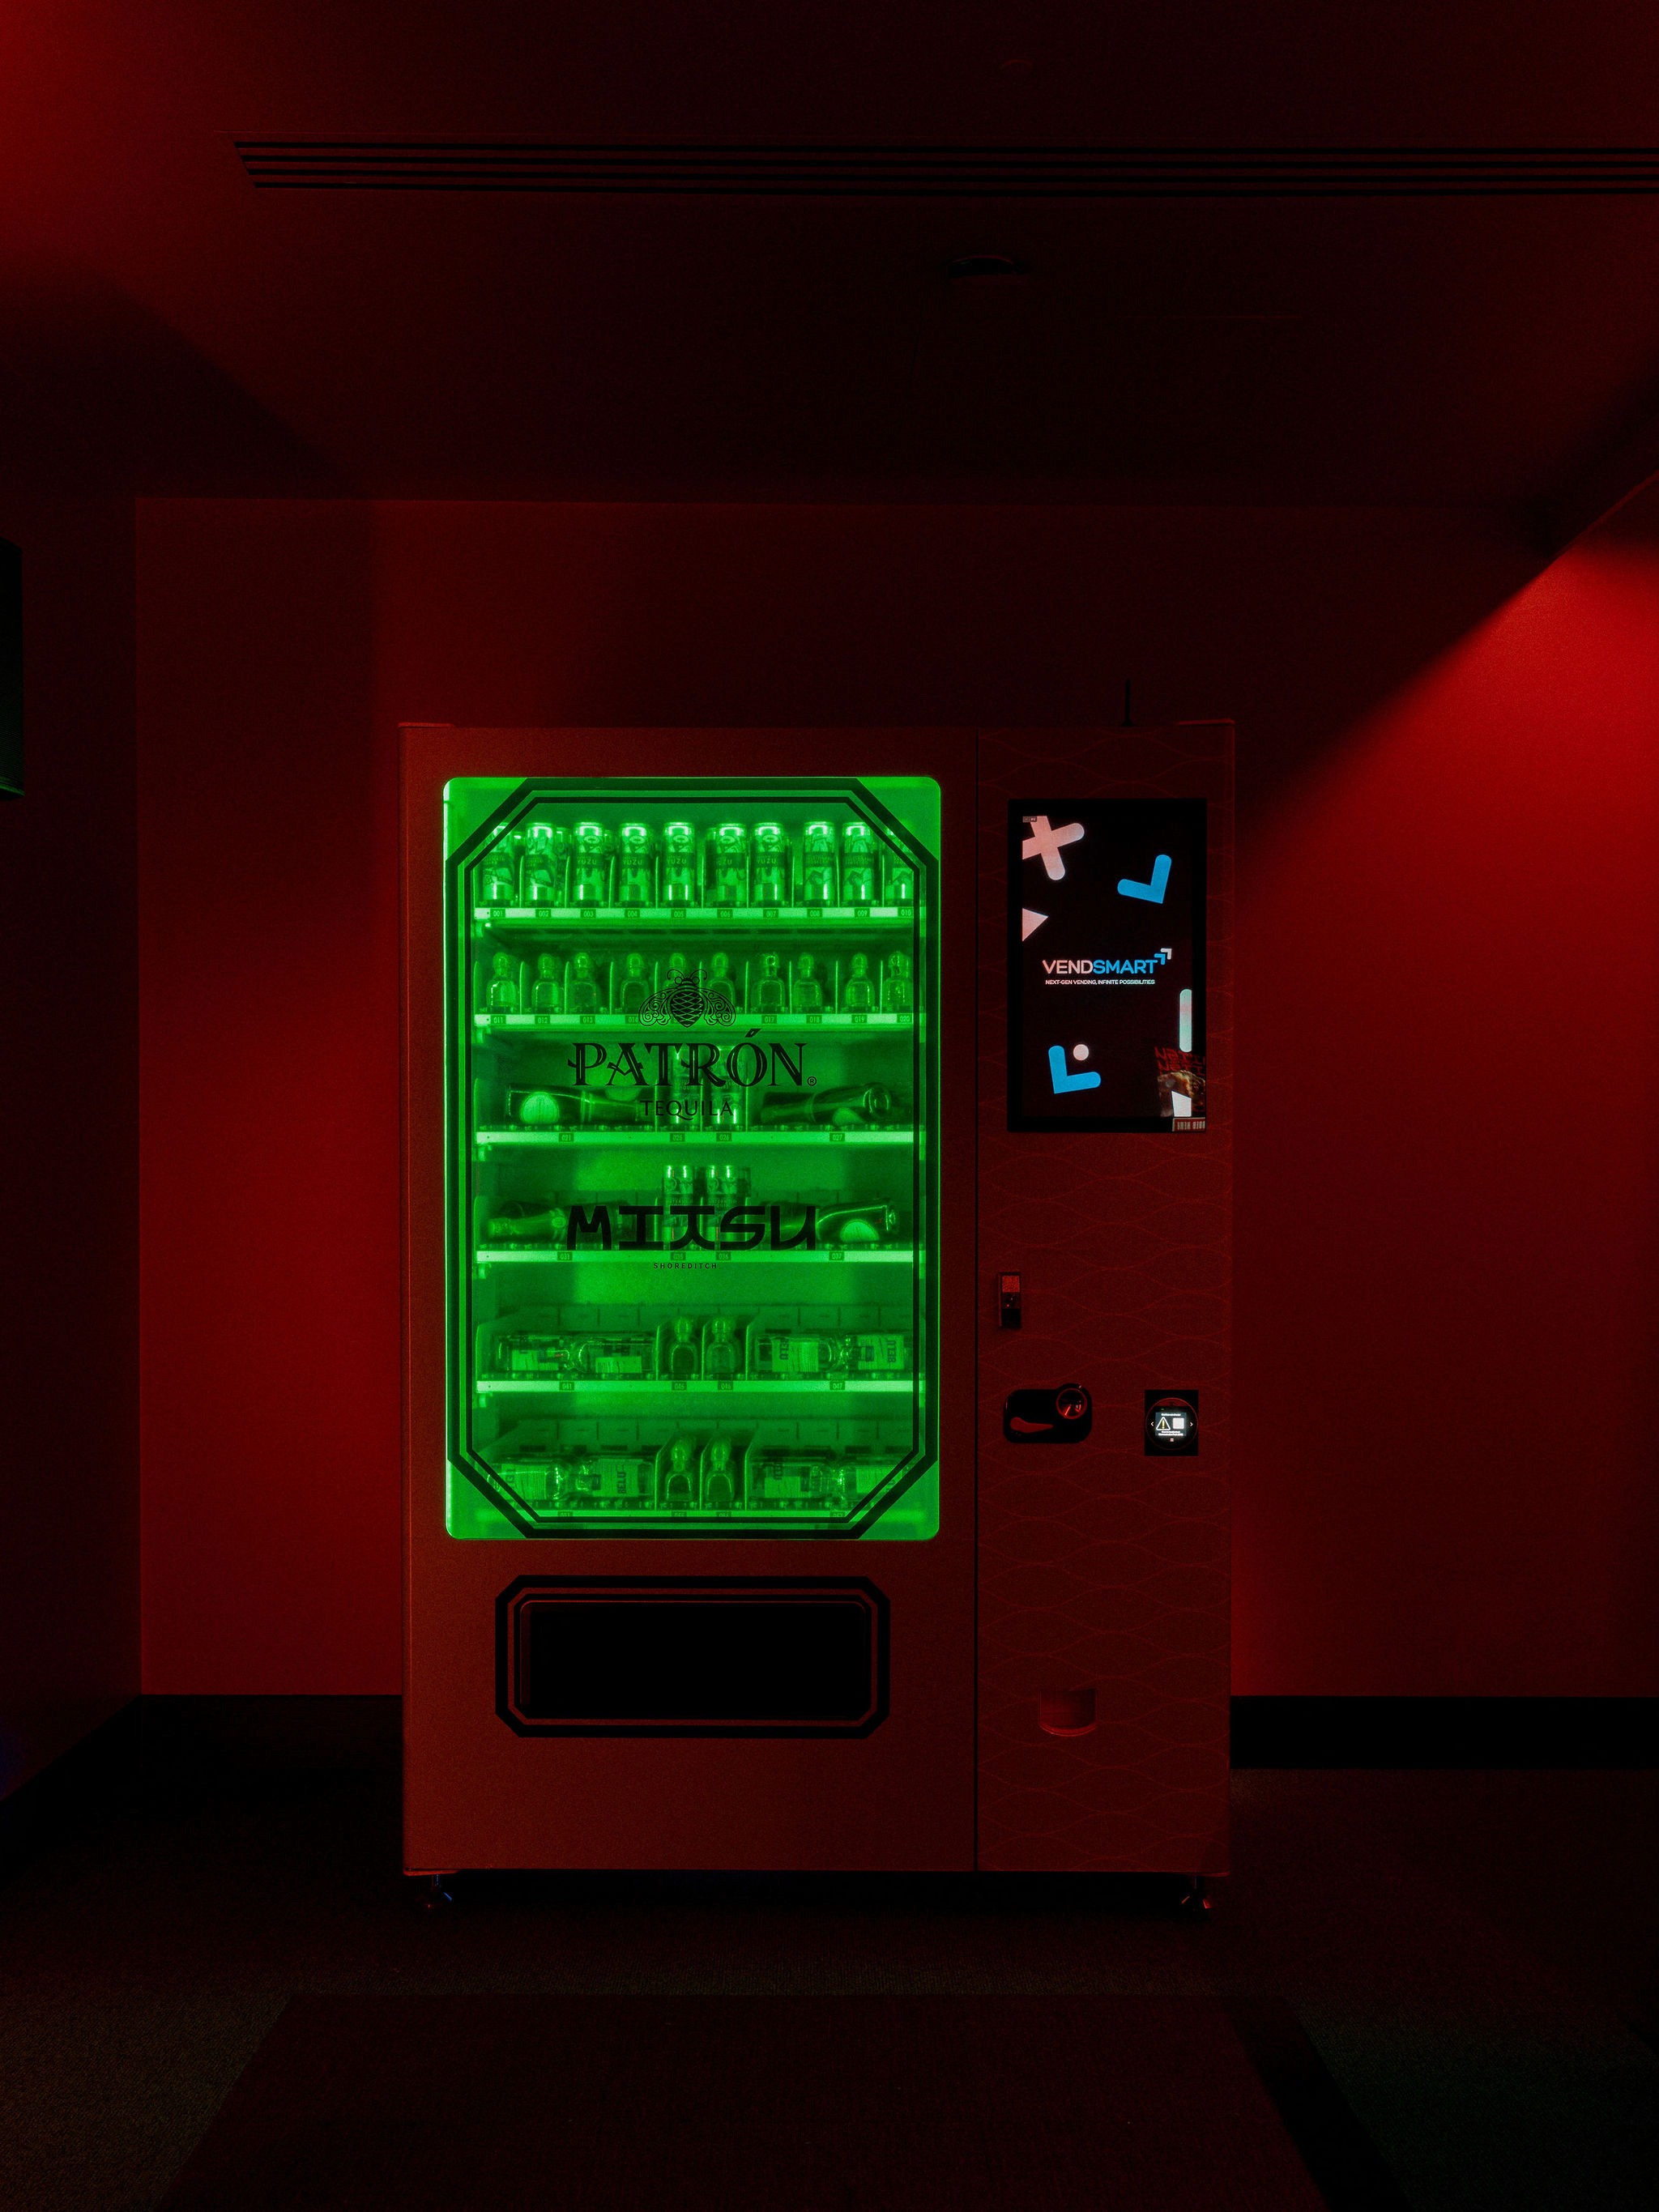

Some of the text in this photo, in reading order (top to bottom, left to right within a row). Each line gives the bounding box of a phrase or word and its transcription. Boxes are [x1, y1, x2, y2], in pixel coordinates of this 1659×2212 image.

[1042, 959, 1158, 974] VENDSMART
[567, 1029, 808, 1087] PATRÓN
[640, 1100, 734, 1121] TEQUILA
[566, 1205, 817, 1251] MITSU
[617, 1471, 626, 1494] BELU
